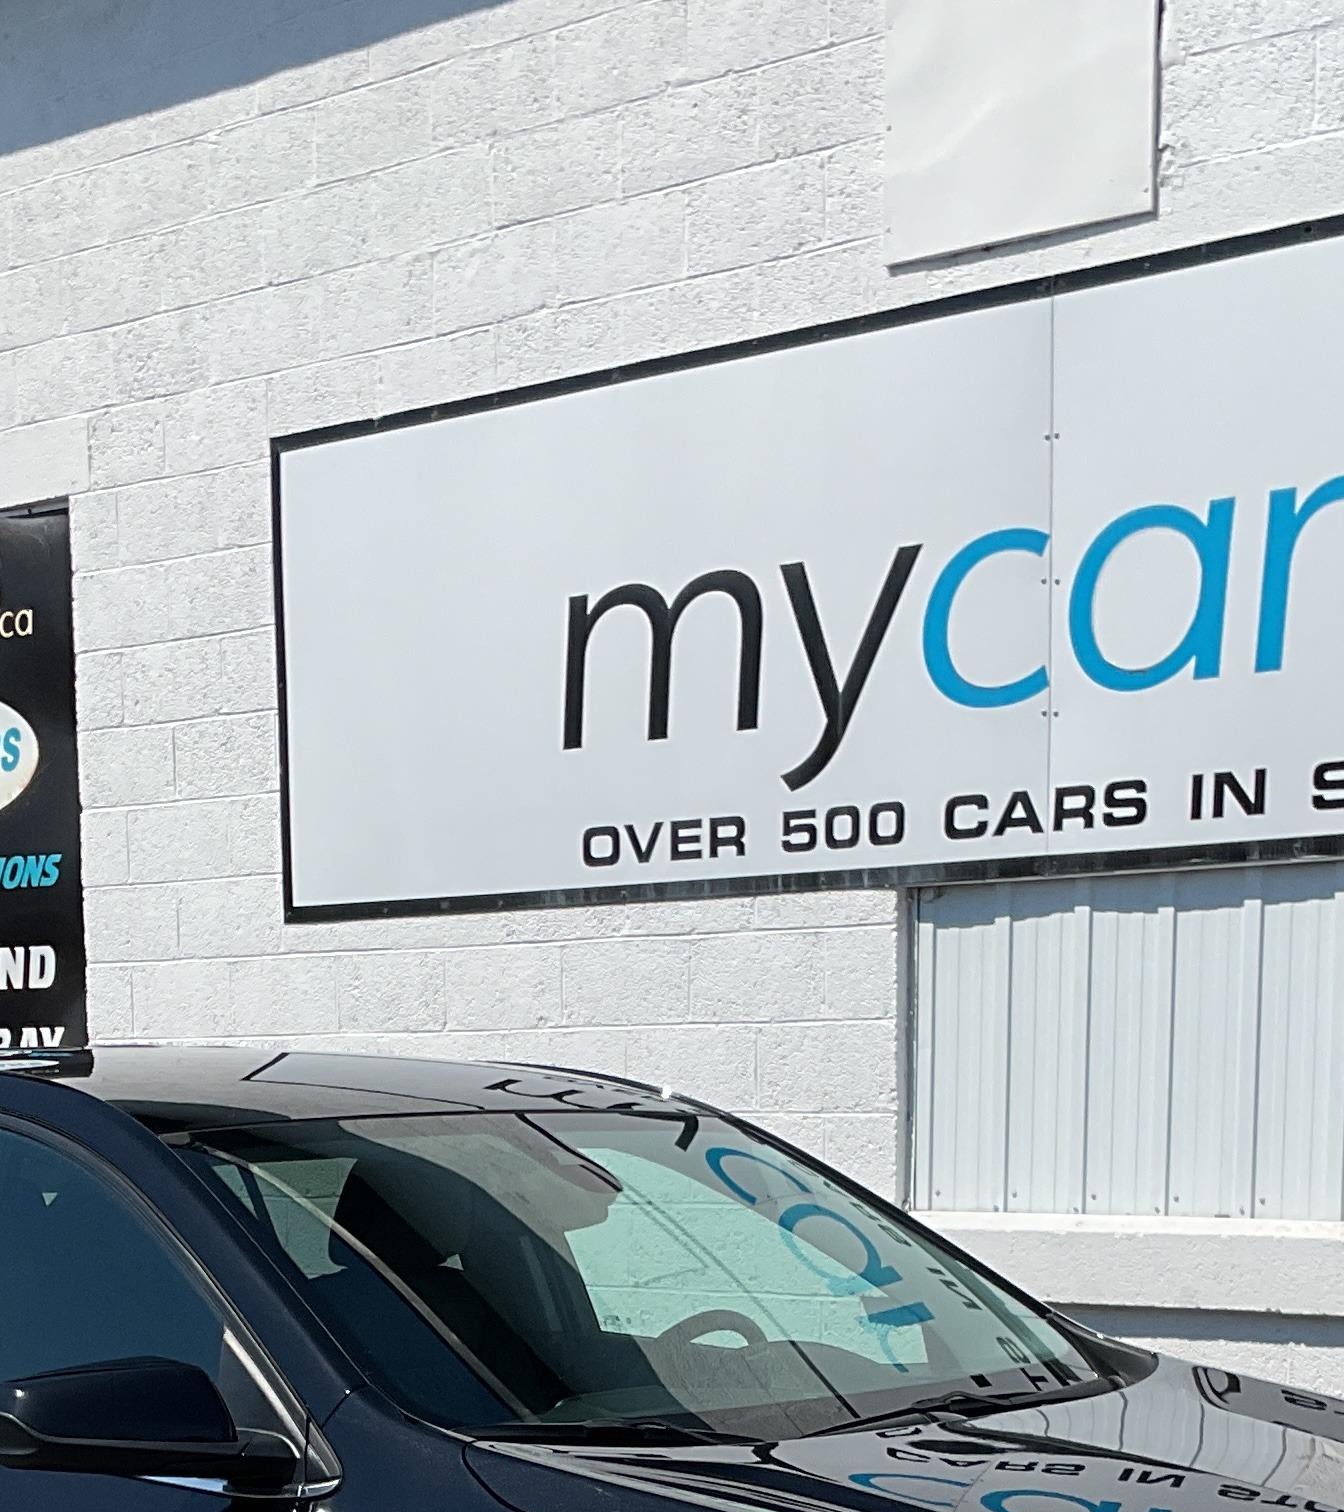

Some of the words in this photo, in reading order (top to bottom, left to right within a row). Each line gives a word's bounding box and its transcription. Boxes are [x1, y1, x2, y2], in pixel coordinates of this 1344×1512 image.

[580, 814, 748, 868] OVER
[779, 800, 907, 853] 500
[942, 780, 1149, 839] CARS
[1189, 769, 1268, 820] IN
